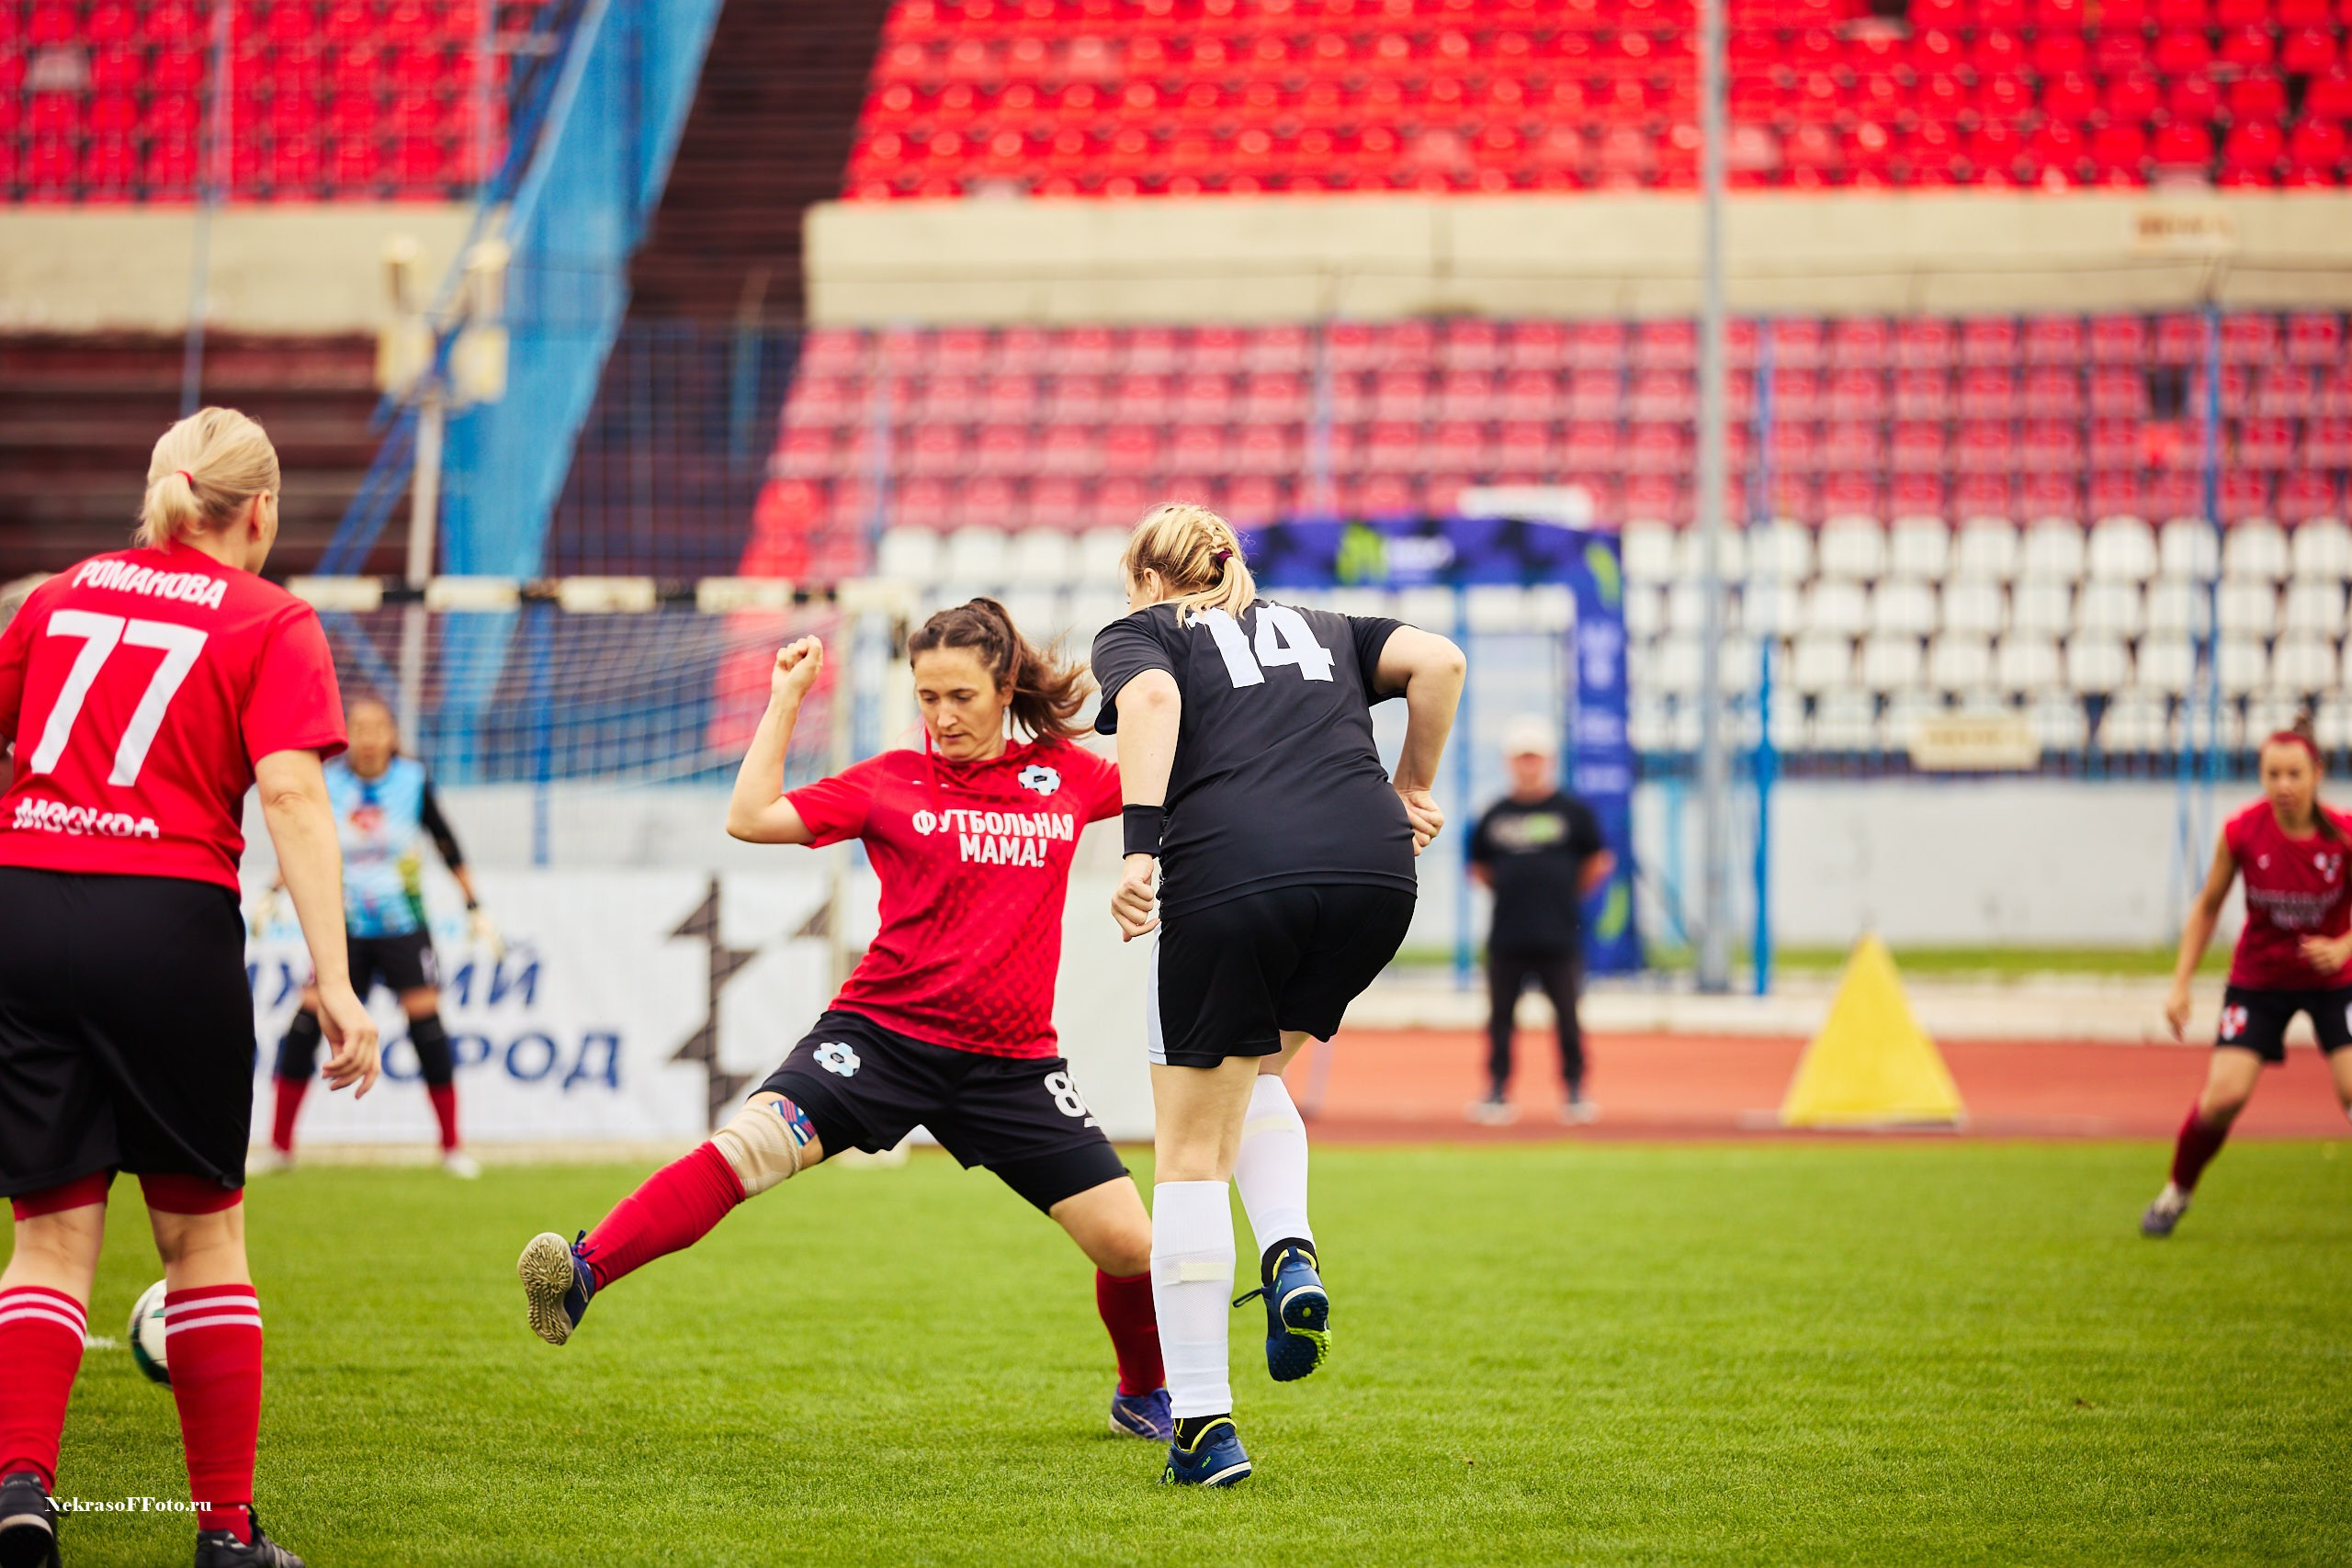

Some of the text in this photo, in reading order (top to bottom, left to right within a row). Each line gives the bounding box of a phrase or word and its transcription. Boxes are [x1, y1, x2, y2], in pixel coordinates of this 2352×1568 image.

[72, 559, 228, 610] РОМАНОВА
[1186, 601, 1336, 689] 14
[30, 609, 209, 786] 77
[911, 808, 1074, 841] ФУТБОЛЬНАЯ
[958, 832, 1047, 868] МАМА!
